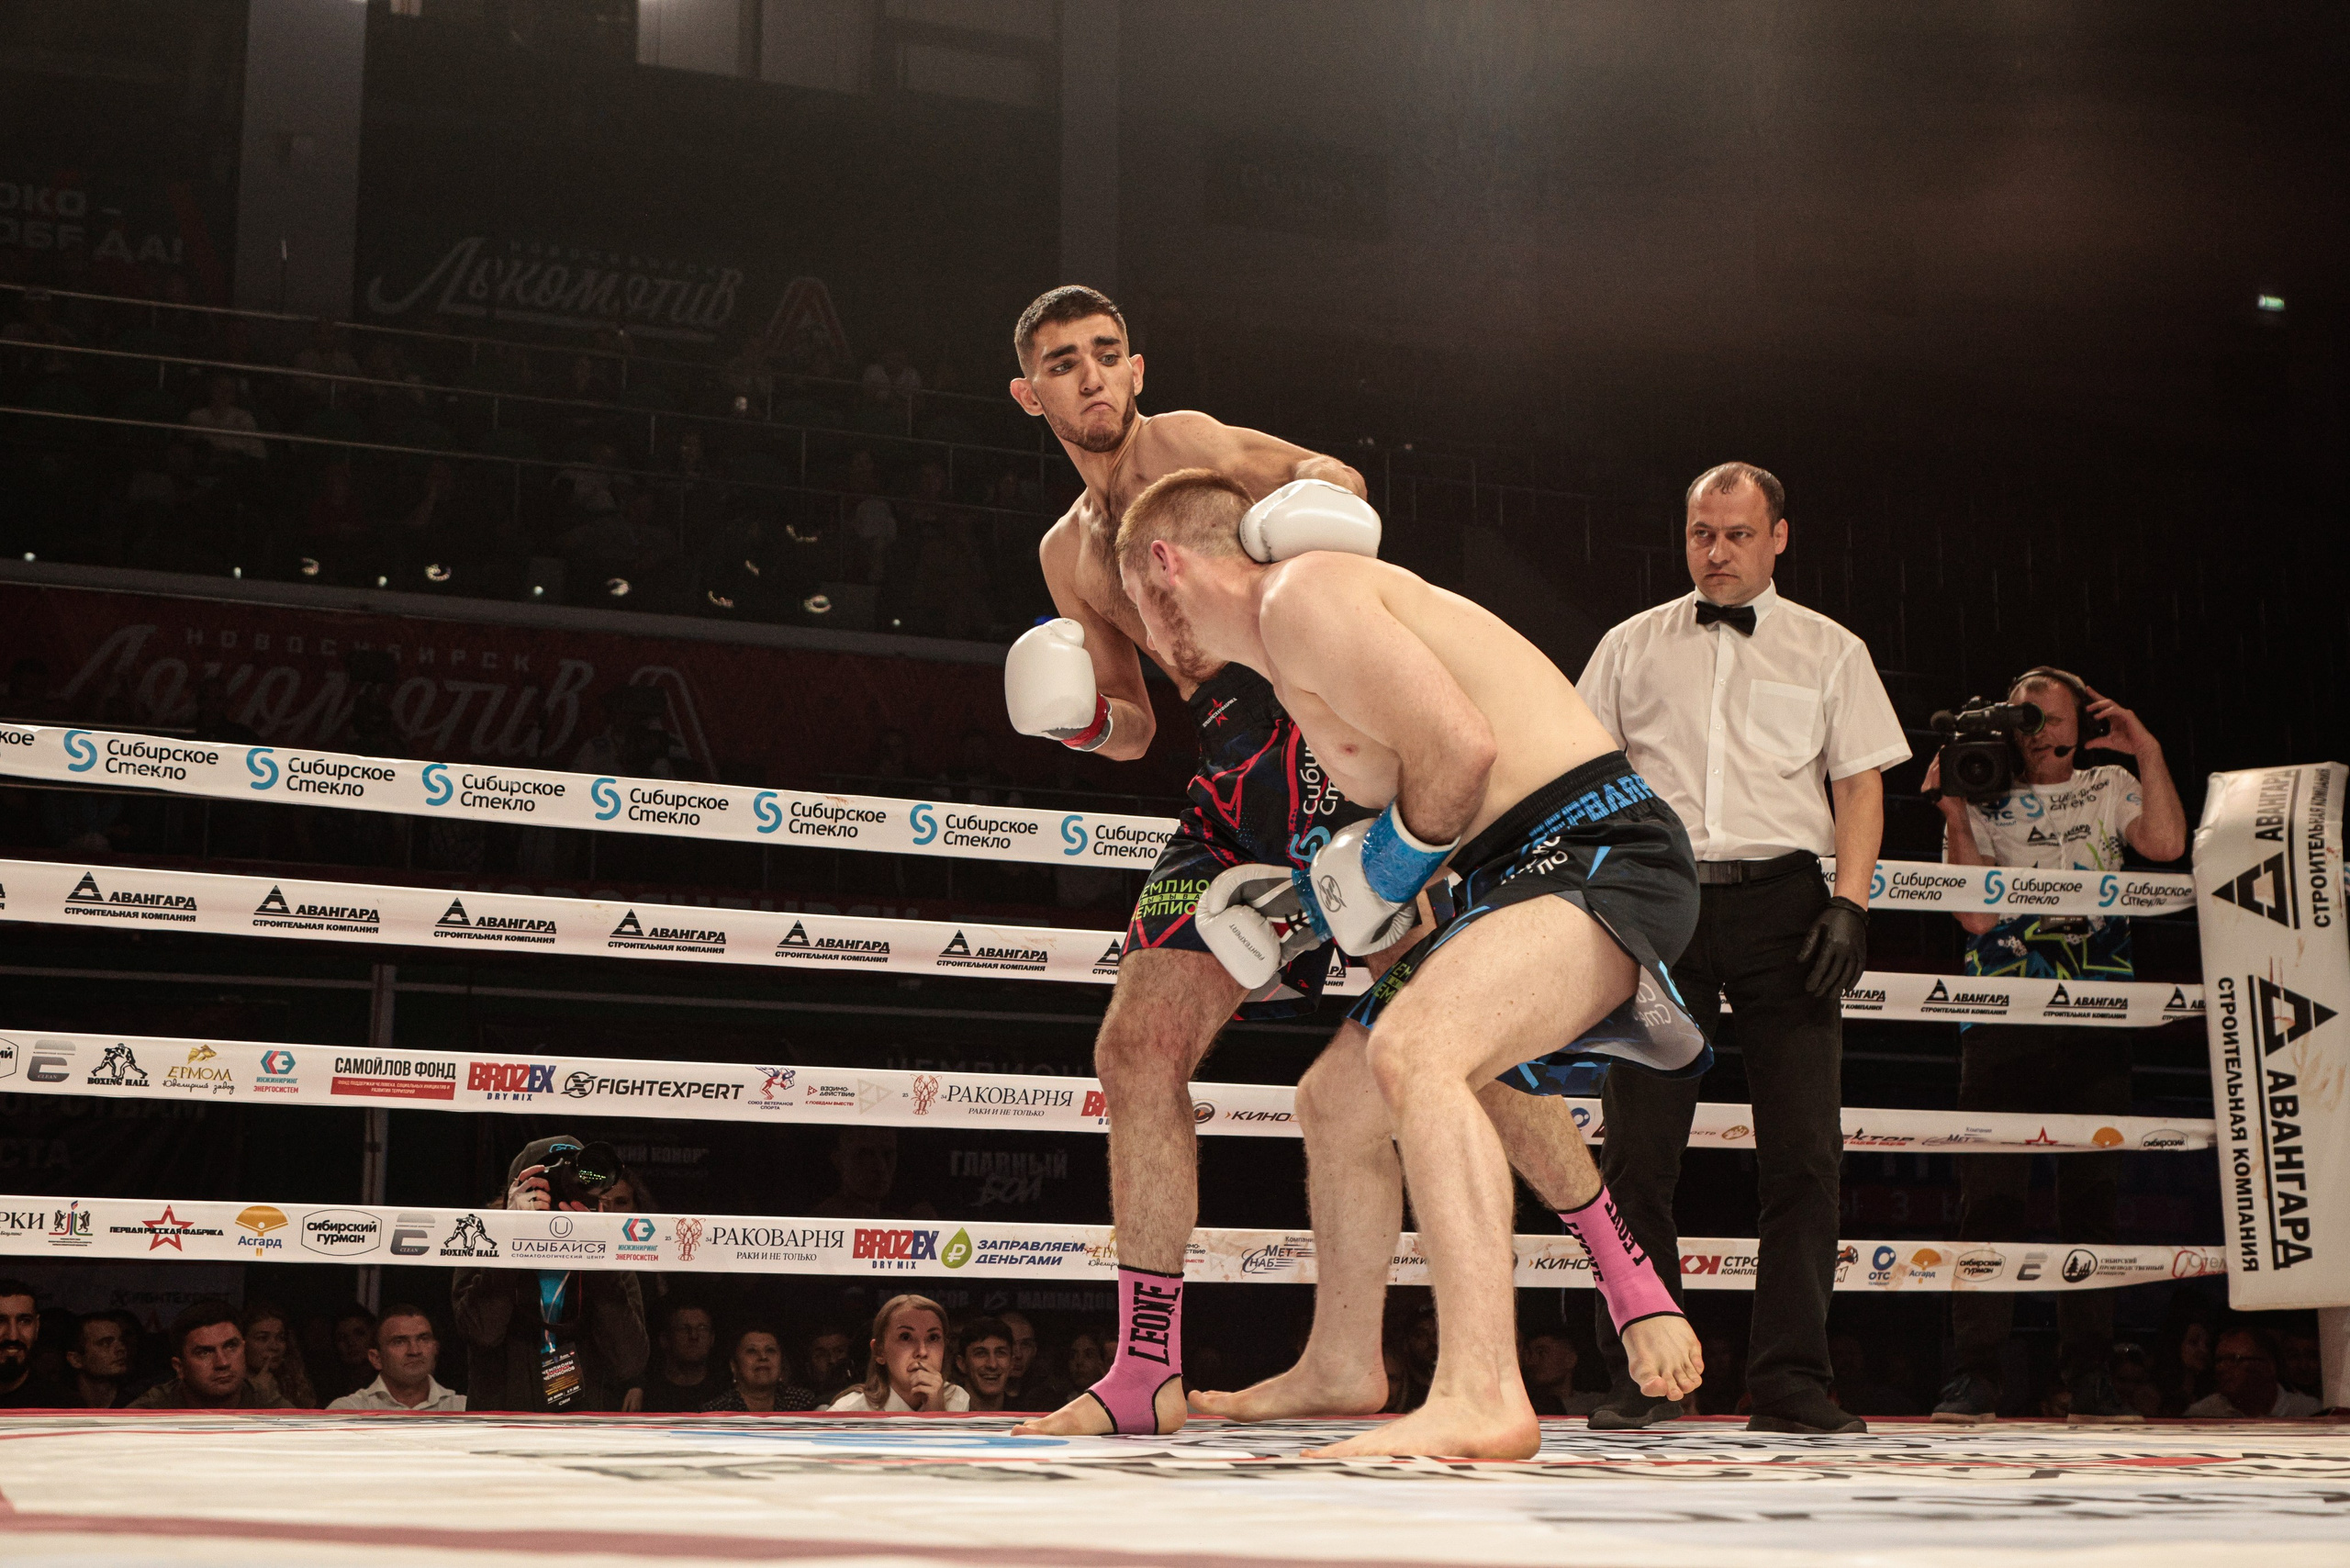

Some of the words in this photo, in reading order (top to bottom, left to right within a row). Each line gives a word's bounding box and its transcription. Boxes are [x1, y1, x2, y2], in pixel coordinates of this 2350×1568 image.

[106, 739, 218, 765] Сибирское
[106, 757, 186, 780] Стекло
[288, 757, 396, 781] Сибирское
[286, 776, 364, 797] Стекло
[462, 774, 565, 797] Сибирское
[460, 791, 535, 812] Стекло
[630, 788, 729, 811] Сибирское
[2255, 768, 2296, 842] АВАНГАРД
[628, 806, 700, 825] Стекло
[790, 801, 886, 823] Сибирское
[788, 819, 858, 838] Стекло
[946, 814, 1038, 834] Сибирское
[943, 831, 1011, 849] Стекло
[1095, 825, 1172, 844] Сибирско
[1093, 842, 1158, 859] Стекло
[2309, 809, 2332, 928] СТРОИТЕЛЬНАЯ
[1141, 879, 1210, 898] ЕМПИО
[1892, 872, 1966, 889] Сибирское
[2011, 879, 2082, 893] Сибирское
[109, 891, 196, 911] АВАНГАРД
[1888, 886, 1942, 901] Стекло
[2008, 891, 2059, 905] Стекло
[64, 907, 139, 918] СТРОИТЕЛЬНАЯ
[141, 912, 196, 922] КОМПАНИЯ
[296, 904, 379, 923] АВАНГАРД
[252, 920, 324, 930] СТРОИТЕЛЬНАЯ
[326, 924, 378, 934] КОМПАНИЯ
[476, 916, 556, 934] АВАНГАРД
[433, 931, 502, 941] СТРОИТЕЛЬНАЯ
[505, 935, 555, 944] КОМПАНИЯ
[649, 927, 726, 944] АВАНГАРД
[608, 941, 674, 951] СТРОИТЕЛЬНАЯ
[676, 945, 724, 954] КОМПАНИЯ
[815, 937, 890, 954] АВАНГАРД
[775, 951, 838, 960] СТРОИТЕЛЬНАЯ
[841, 955, 888, 963] КОМПАНИЯ
[976, 947, 1048, 962] АВАНГАРД
[936, 960, 999, 969] СТРОИТЕЛЬНАЯ
[1000, 963, 1046, 971] КОМПАНИЯ
[1953, 993, 2009, 1006] АВАНГАРД
[2074, 997, 2128, 1009] АВАНГАРД
[1921, 1006, 1969, 1014] СТРОИТЕЛЬНАЯ
[2218, 977, 2248, 1141] СТРОИТЕЛЬНАЯ
[334, 1057, 411, 1077] САМОЙЛОВ
[415, 1062, 457, 1080] ФОНД
[87, 1077, 124, 1086] BOXING
[126, 1079, 150, 1087] HALL
[256, 1076, 298, 1084] ИНЖИНИРИНГ
[467, 1062, 557, 1093] BROZEX
[253, 1085, 299, 1093] ЭНЕРГОСИСТЕМ
[487, 1092, 508, 1101] DRY
[512, 1093, 532, 1102] MIX
[596, 1079, 744, 1100] FIGHTEXPERT
[947, 1085, 1073, 1107] РАКОВАРНЯ
[2266, 1070, 2312, 1270] АВАНГАРД
[2232, 1148, 2259, 1272] КОМПАНИЯ
[307, 1220, 377, 1232] сибирский
[238, 1236, 282, 1249] Асгард
[317, 1234, 364, 1245] гурман
[713, 1227, 845, 1249] РАКОВАРНЯ
[853, 1228, 939, 1260] BROZEX
[978, 1240, 1085, 1252] ЗАПРАВЛЯЕМ
[440, 1249, 474, 1258] BOXING
[975, 1255, 1063, 1265] ДЕНЬГАМИ
[872, 1260, 890, 1269] DRY
[1960, 1258, 2002, 1267] сибирский
[1869, 1271, 1891, 1280] ОТС
[1909, 1270, 1936, 1278] Асгард
[1128, 1282, 1181, 1367] LEONE
